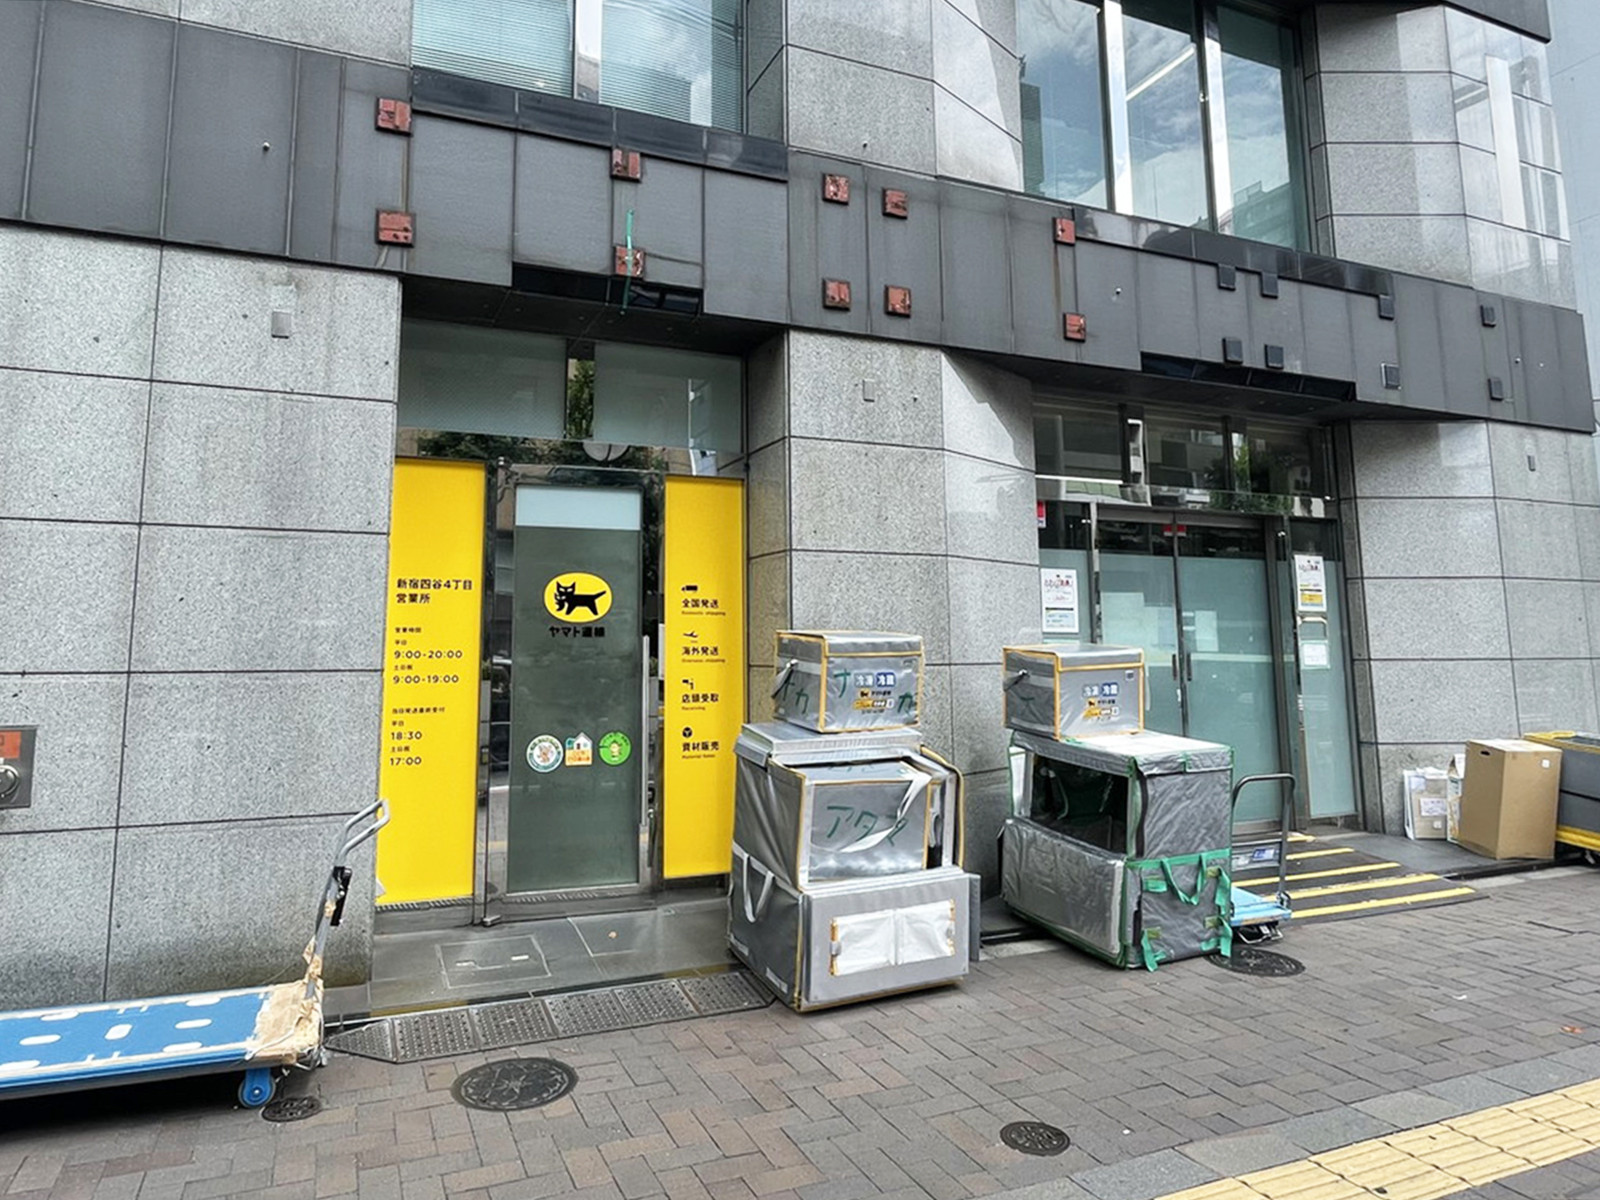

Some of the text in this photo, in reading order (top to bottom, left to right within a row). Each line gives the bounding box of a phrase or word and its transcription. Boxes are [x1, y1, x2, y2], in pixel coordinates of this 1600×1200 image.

[397, 578, 472, 590] 新宿四谷4丁目
[396, 593, 430, 604] 営業所
[682, 598, 719, 609] 全国発送
[394, 650, 463, 659] 9:00-20:00
[682, 646, 719, 656] 海外発送
[393, 675, 459, 684] 9:00-19:00
[682, 693, 719, 703] 店頭受取
[391, 731, 422, 740] 18:30
[682, 741, 719, 752] 資材販売
[390, 757, 422, 766] 17:00
